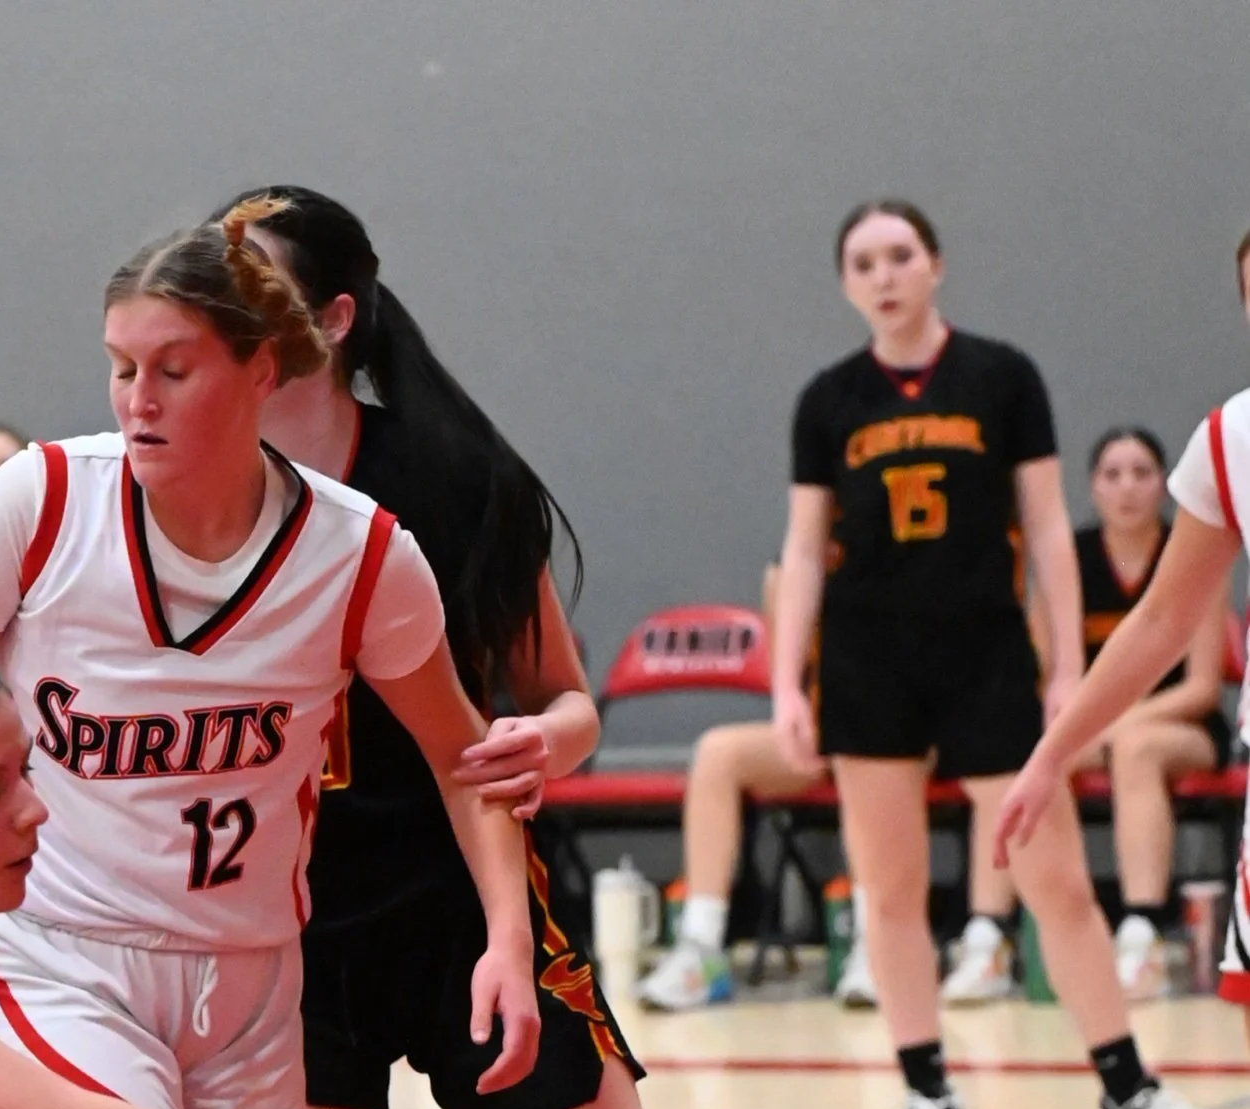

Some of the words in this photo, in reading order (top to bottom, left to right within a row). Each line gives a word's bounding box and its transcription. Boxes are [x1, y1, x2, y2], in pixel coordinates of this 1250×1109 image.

[881, 462, 948, 543] 15
[34, 677, 293, 780] SPIRITS
[180, 796, 257, 892] 12
